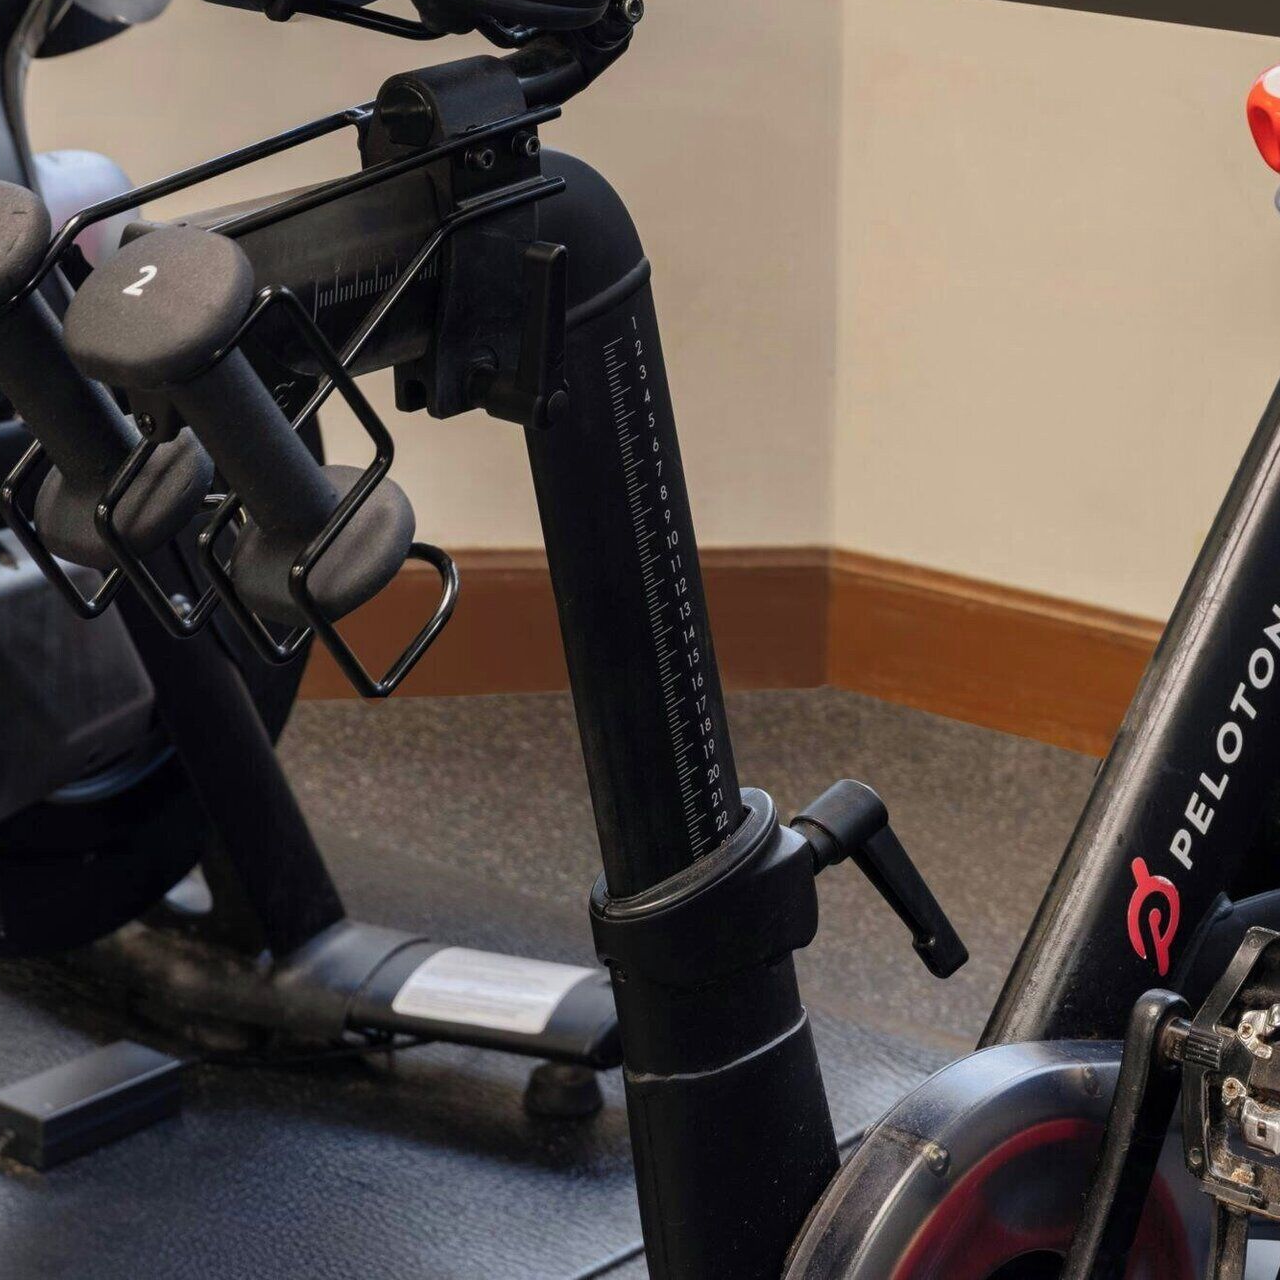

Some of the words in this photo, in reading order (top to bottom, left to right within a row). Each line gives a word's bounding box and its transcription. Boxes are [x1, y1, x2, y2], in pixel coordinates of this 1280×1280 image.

[122, 265, 158, 296] 2
[631, 316, 637, 330] 1
[635, 340, 643, 357] 2
[639, 365, 647, 380] 3
[644, 388, 651, 402] 4
[648, 412, 655, 428] 5
[652, 437, 659, 452] 6
[656, 460, 662, 477] 7
[660, 485, 668, 500] 8
[664, 509, 671, 524] 9
[666, 530, 679, 549] 10
[670, 554, 682, 573] 11
[674, 577, 688, 597] 12
[679, 601, 692, 621] 13
[683, 624, 696, 644] 14
[687, 648, 699, 667] 15
[691, 672, 704, 692] 16
[695, 694, 707, 715] 17
[699, 717, 712, 736] 18
[703, 739, 715, 760] 19
[707, 763, 720, 784] 20
[711, 787, 723, 808] 21
[715, 810, 728, 832] 22
